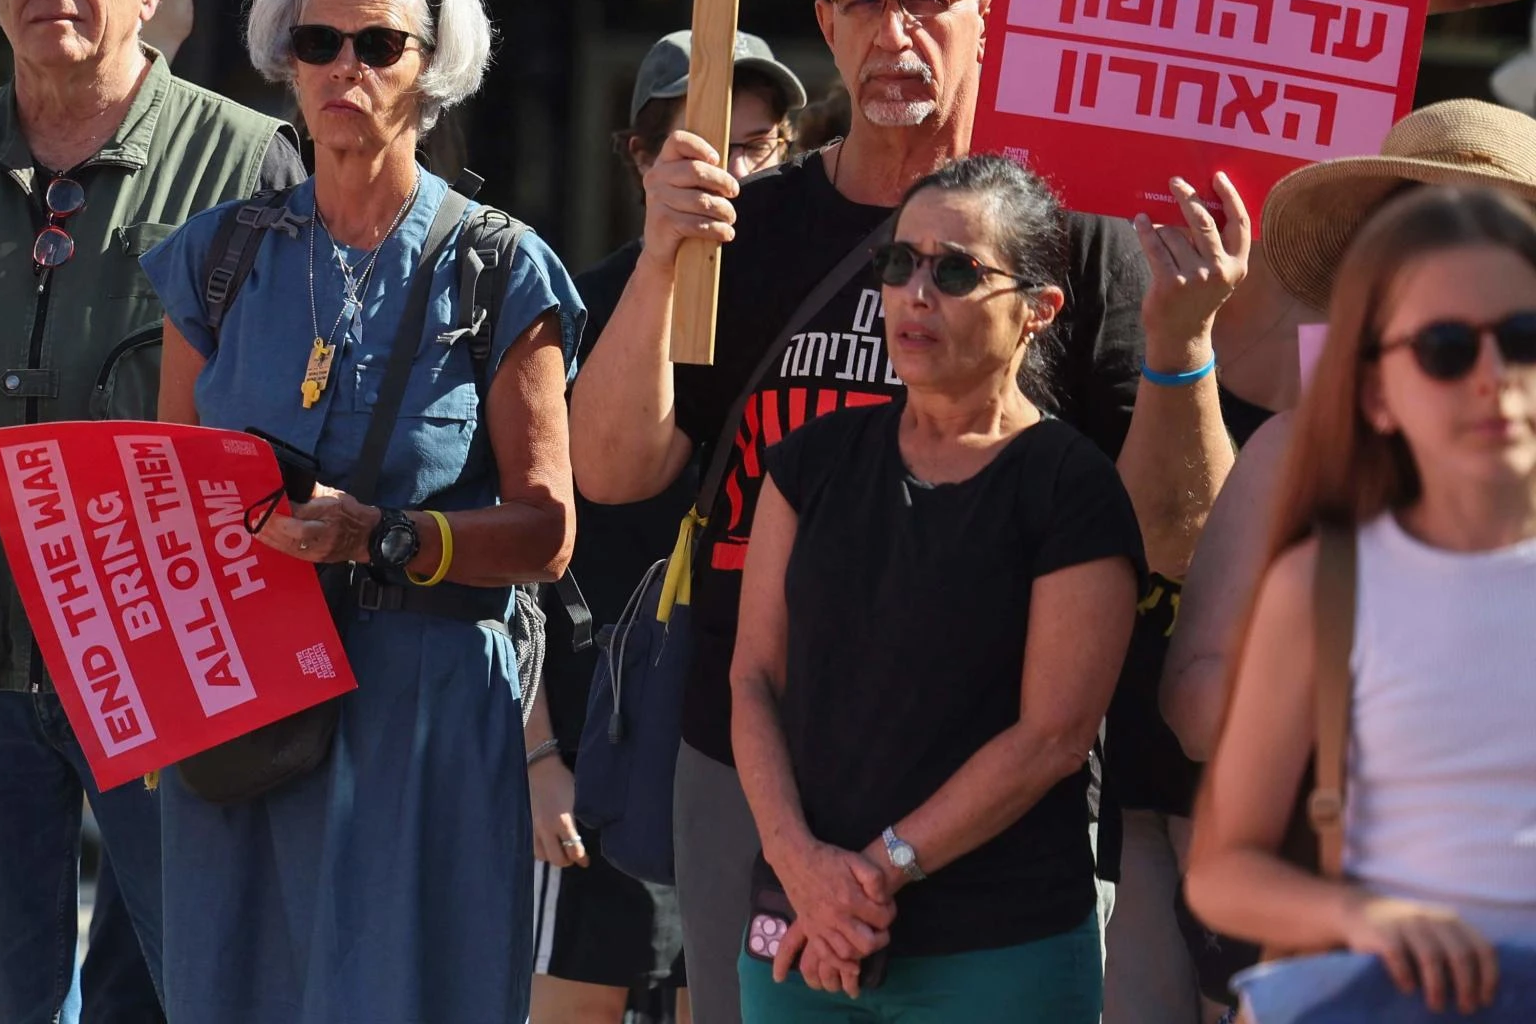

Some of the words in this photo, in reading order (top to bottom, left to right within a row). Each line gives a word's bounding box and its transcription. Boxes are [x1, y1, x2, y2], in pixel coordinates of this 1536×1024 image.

[1054, 50, 1337, 146] האחרון
[780, 332, 881, 383] הביתה
[18, 447, 66, 531] WAR
[139, 443, 181, 521] THEM
[87, 490, 162, 641] BRING
[157, 531, 199, 589] OF
[201, 480, 266, 600] HOME
[40, 539, 96, 637] THE
[187, 597, 240, 688] ALL
[81, 644, 143, 744] END
